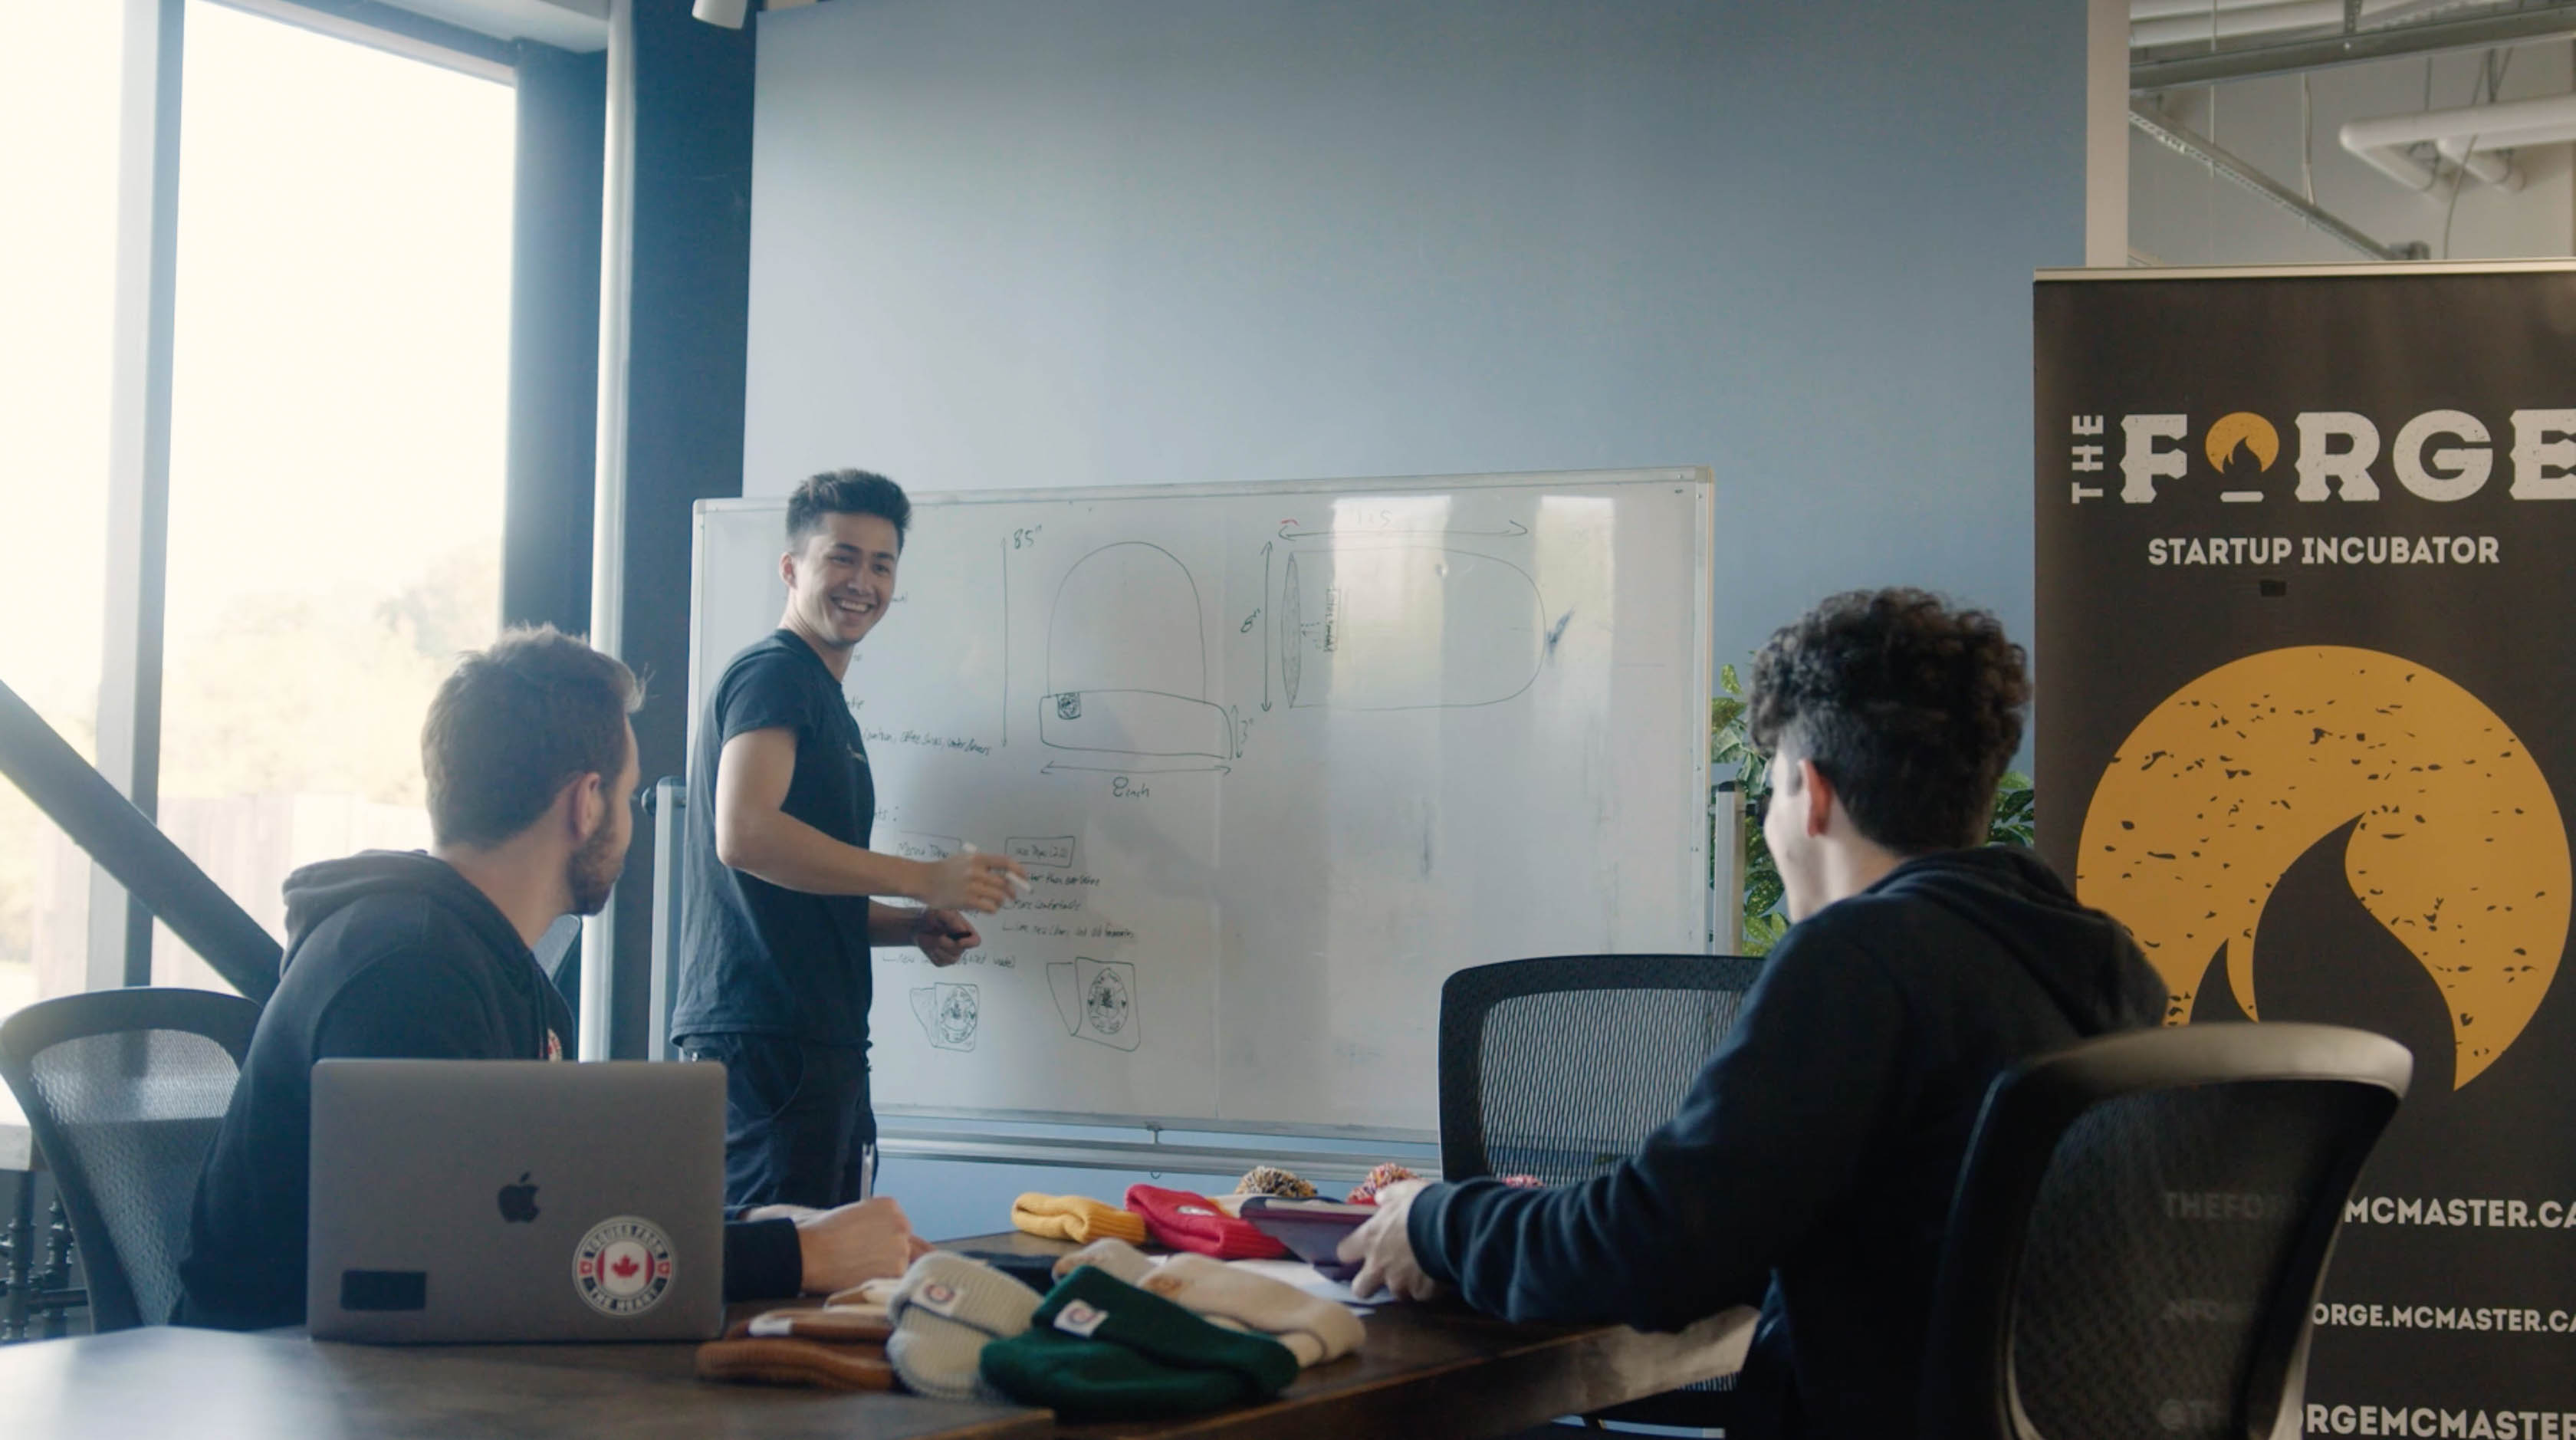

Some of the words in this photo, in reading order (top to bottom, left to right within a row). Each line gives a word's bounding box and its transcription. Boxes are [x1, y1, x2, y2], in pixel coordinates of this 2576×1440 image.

[2072, 415, 2104, 504] THE
[2148, 537, 2292, 566] STARTUP
[2302, 536, 2500, 564] INCUBATOR
